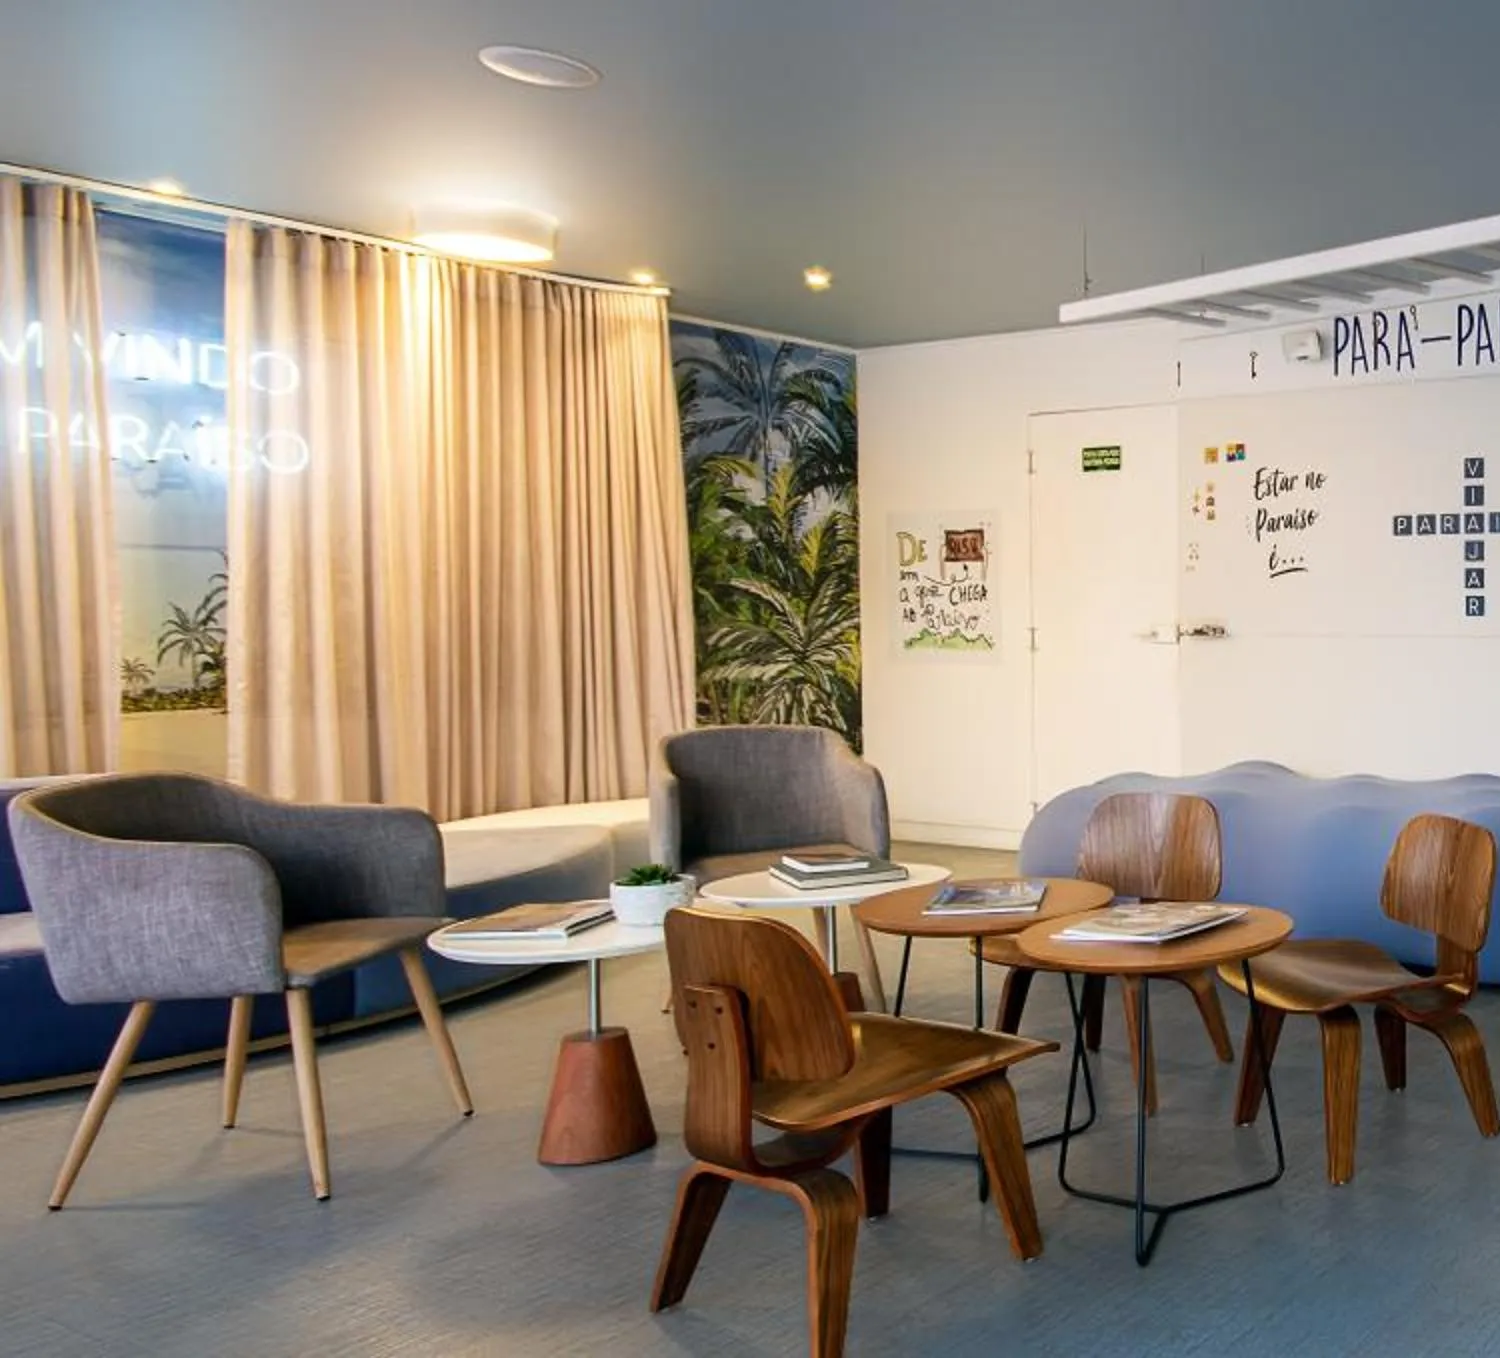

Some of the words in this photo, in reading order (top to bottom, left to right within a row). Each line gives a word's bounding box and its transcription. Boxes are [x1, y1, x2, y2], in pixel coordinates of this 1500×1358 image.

[1253, 466, 1298, 501] Estar
[1305, 471, 1327, 491] no
[896, 531, 928, 566] DE
[1465, 459, 1483, 615] VIAJAR
